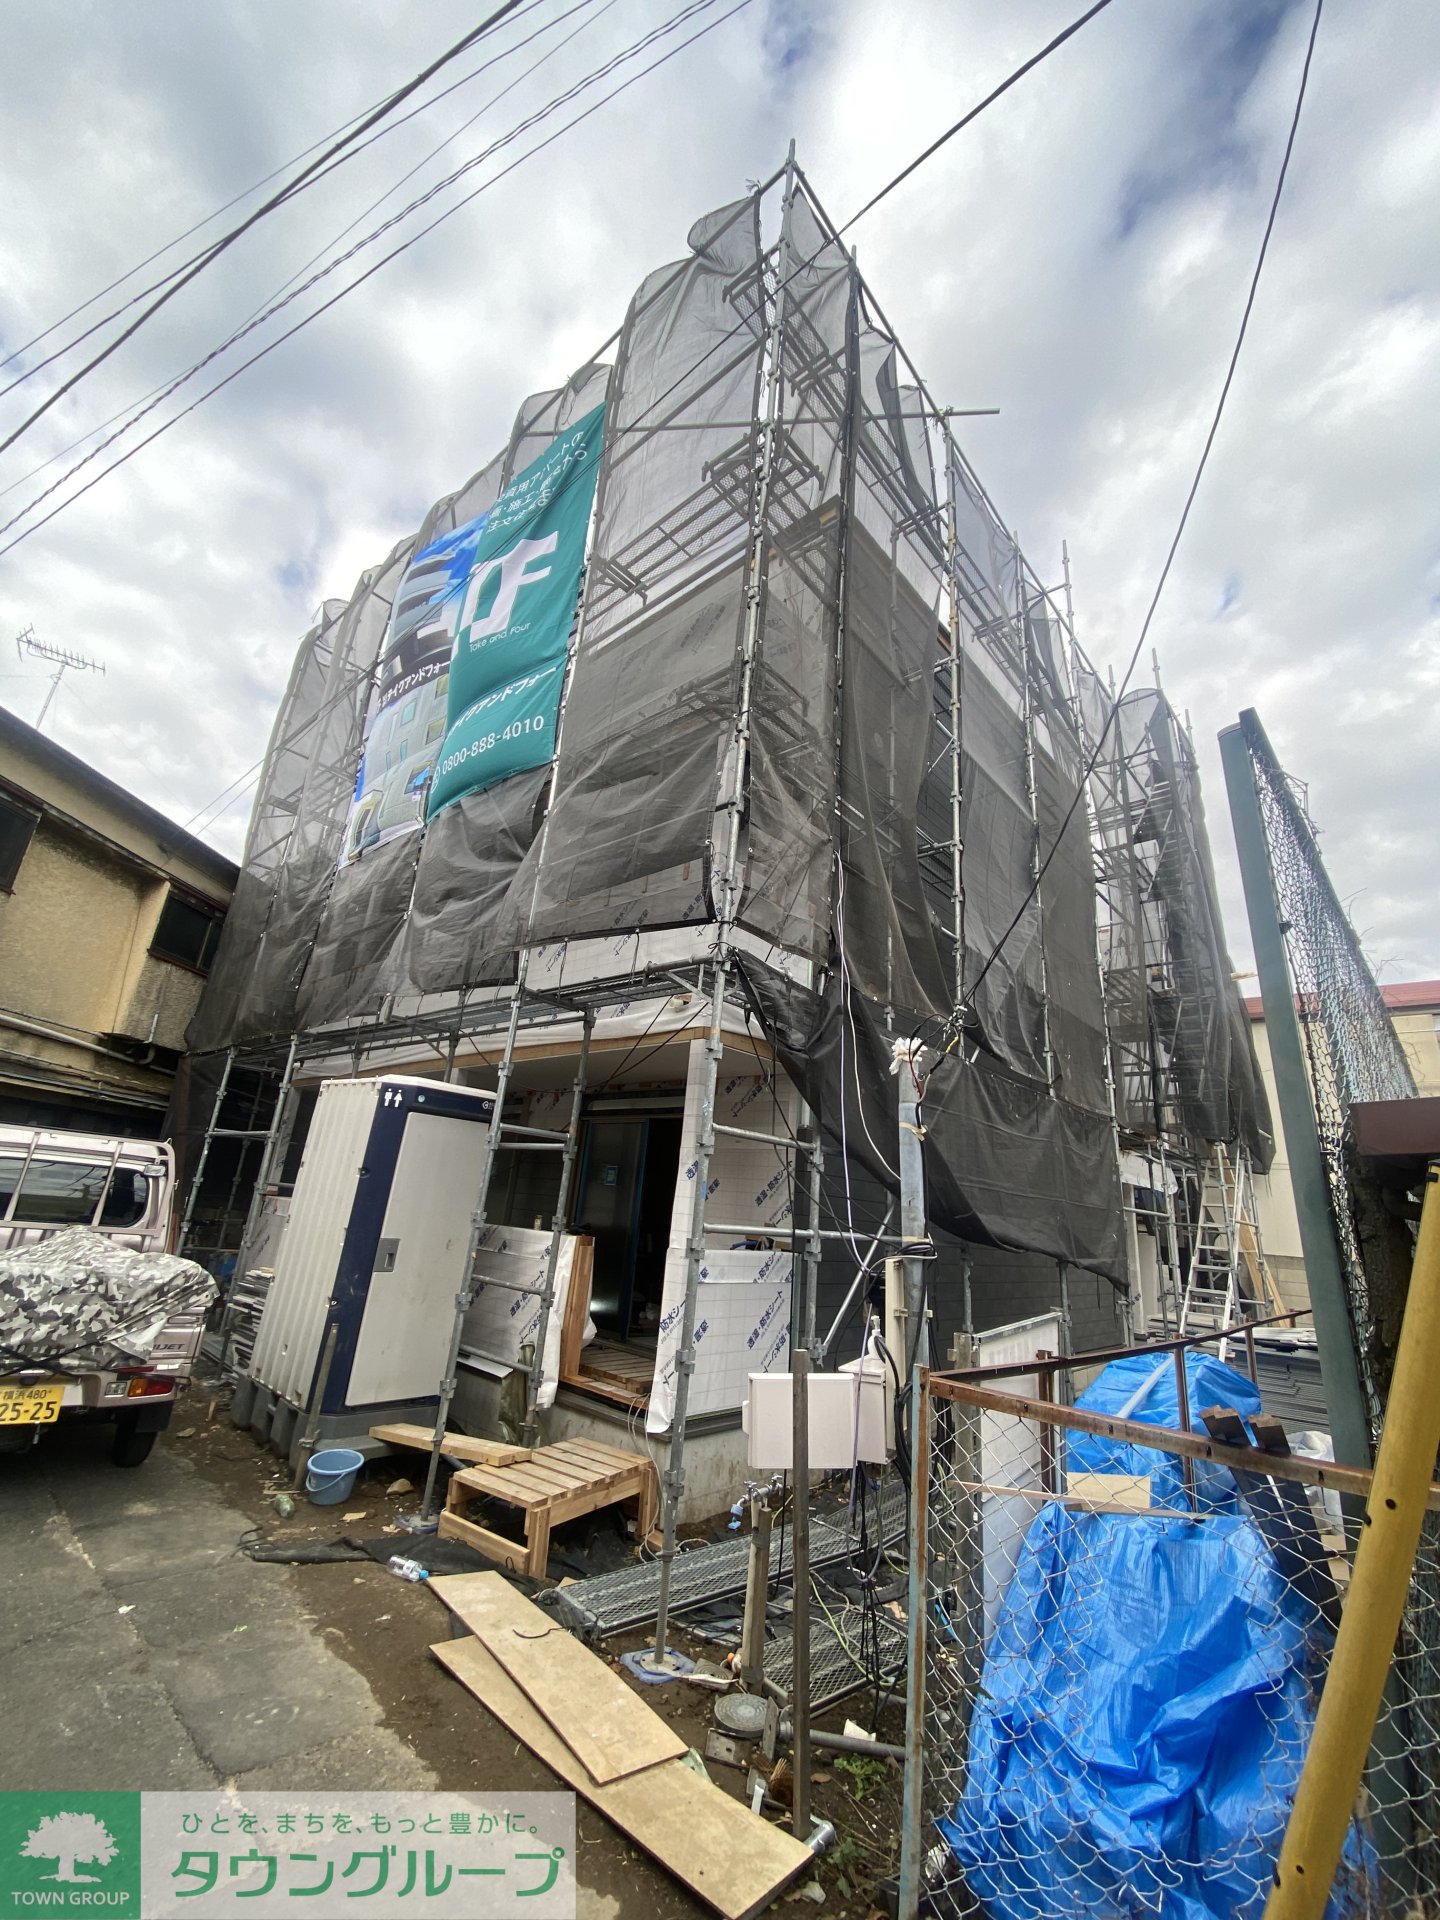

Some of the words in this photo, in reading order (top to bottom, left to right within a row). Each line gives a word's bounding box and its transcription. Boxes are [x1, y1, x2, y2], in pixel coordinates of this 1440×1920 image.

[469, 639, 487, 653] Take
[489, 630, 507, 644] and
[510, 622, 531, 635] Four
[442, 715, 545, 775] 0800-888-4010
[0, 1400, 57, 1422] 25-25
